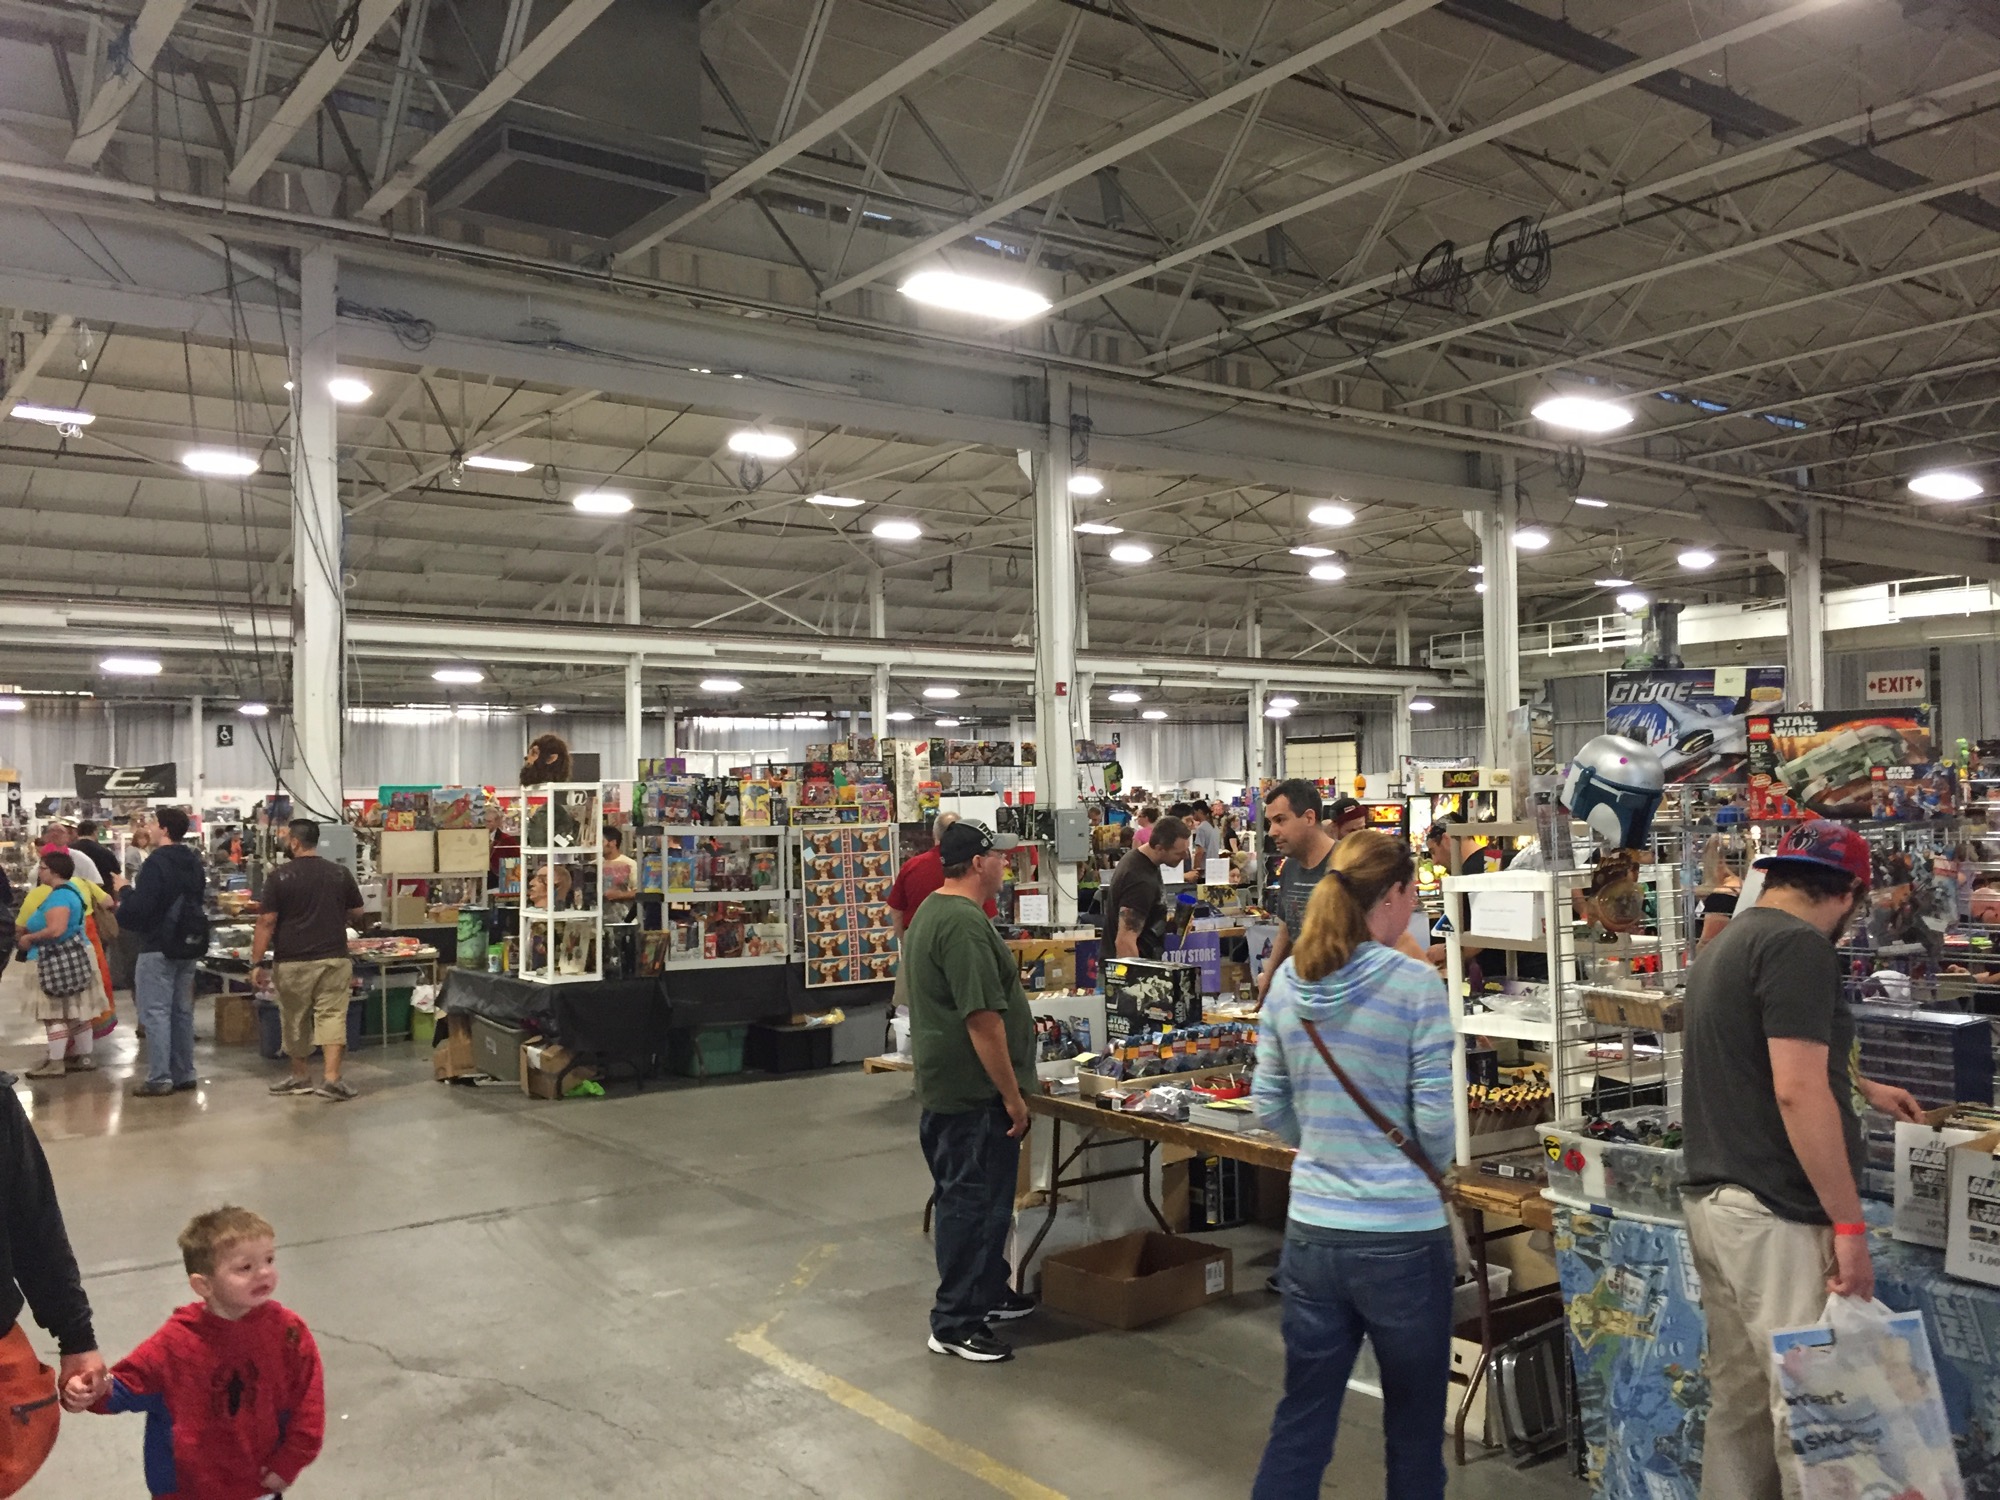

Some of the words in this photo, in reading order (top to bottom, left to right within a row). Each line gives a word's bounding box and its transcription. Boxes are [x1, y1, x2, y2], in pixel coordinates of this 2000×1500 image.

[1878, 676, 1914, 693] EXIT
[1773, 716, 1818, 727] STAR
[1774, 726, 1818, 737] WARS
[1886, 772, 1914, 780] WARS
[1169, 950, 1188, 963] TOY
[1187, 947, 1217, 962] STORE
[1108, 1014, 1130, 1025] STAR
[1108, 1022, 1130, 1034] WARS
